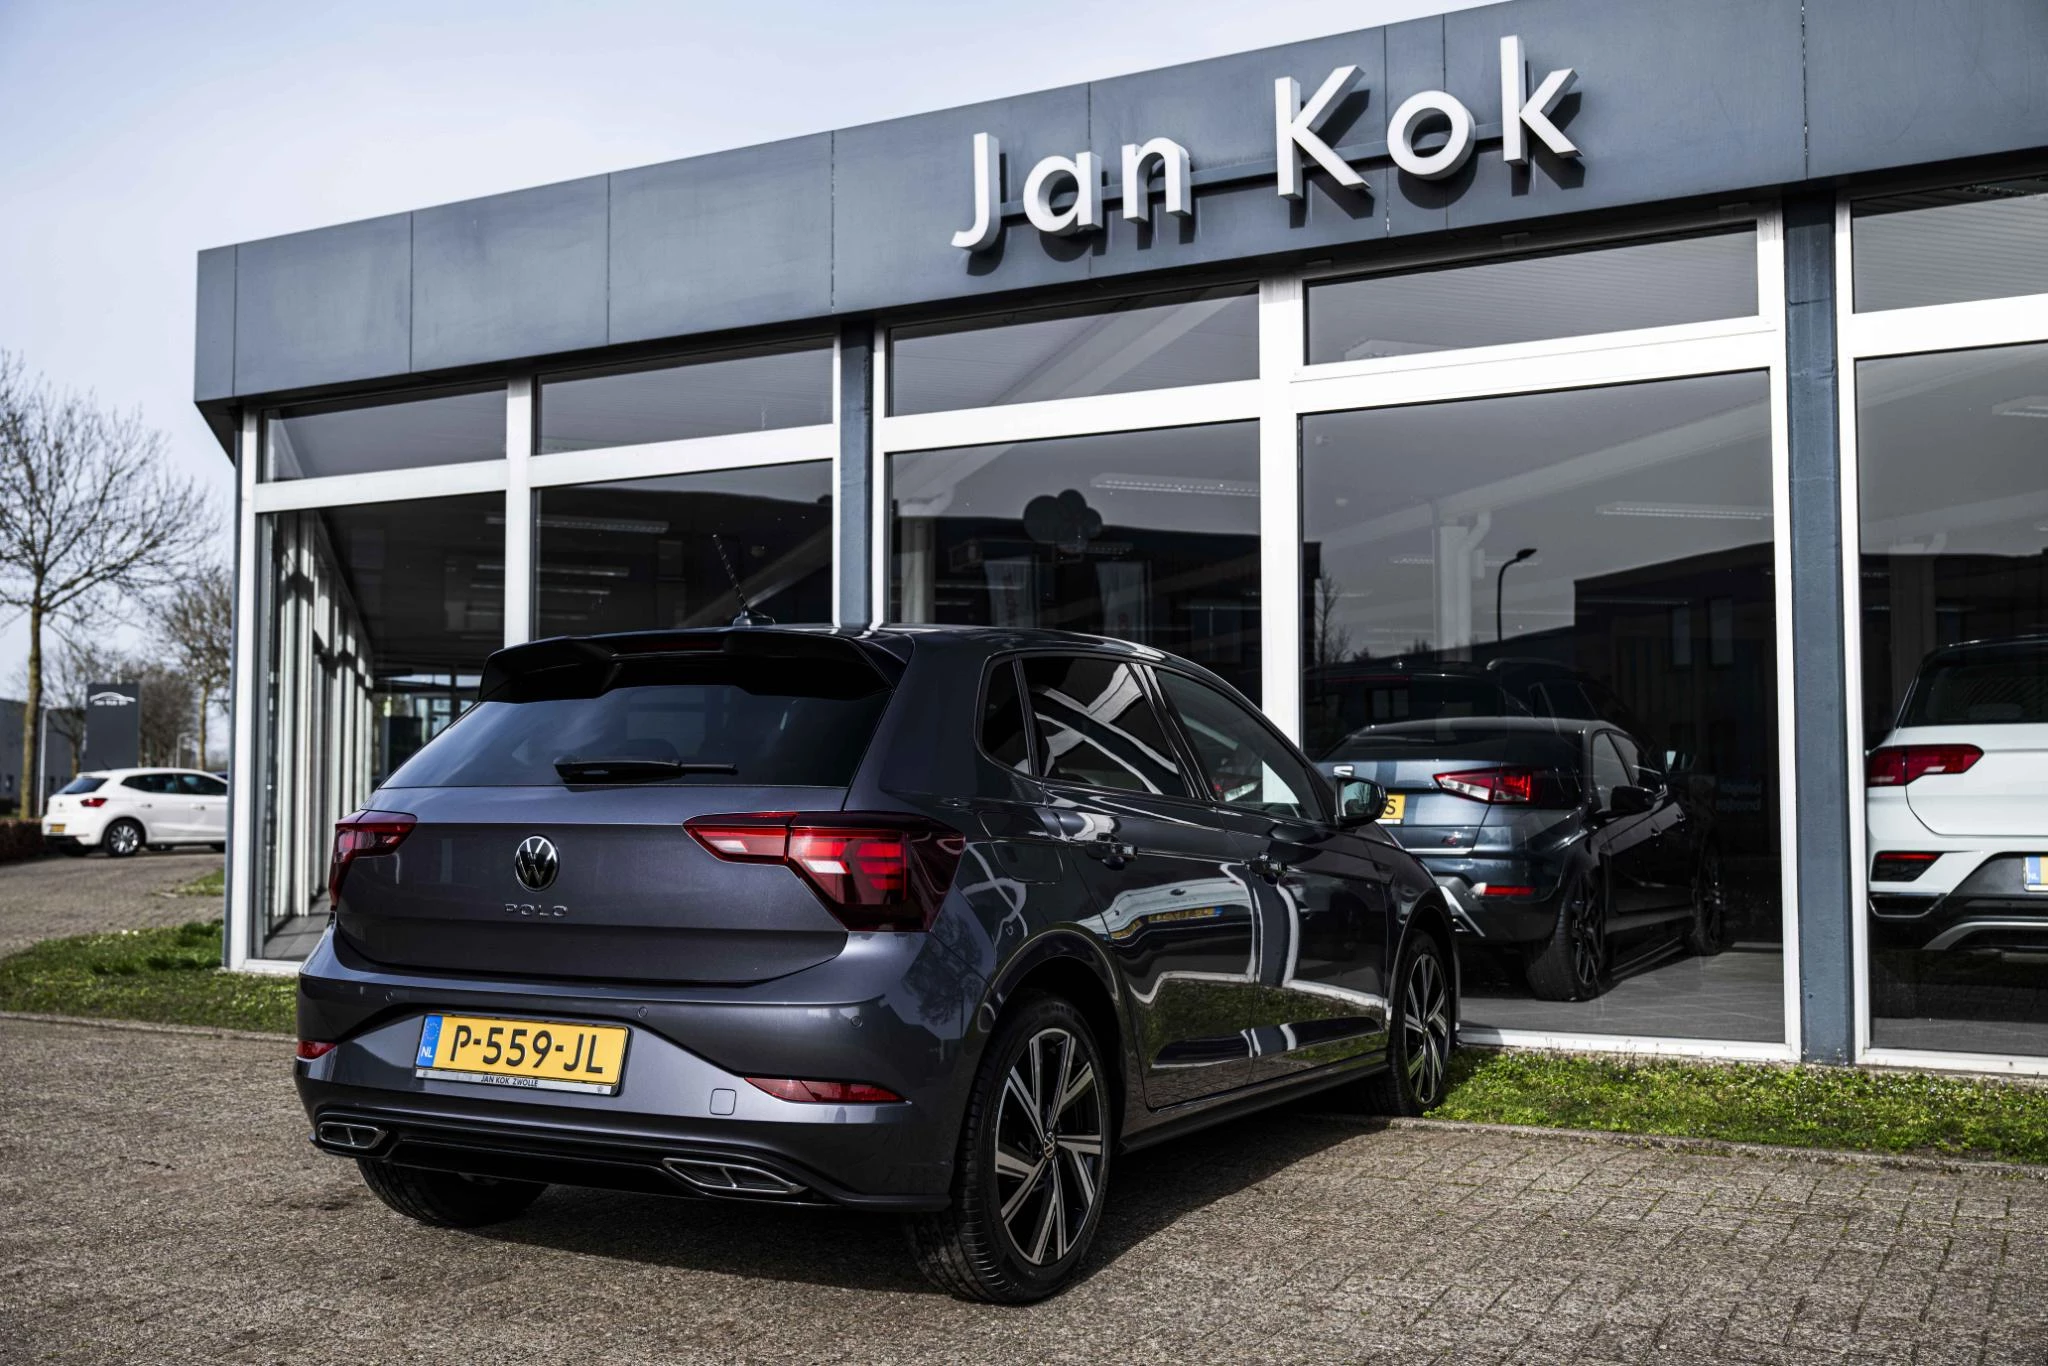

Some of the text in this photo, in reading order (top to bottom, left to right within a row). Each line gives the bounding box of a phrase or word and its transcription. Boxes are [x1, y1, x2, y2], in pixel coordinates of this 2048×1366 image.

[951, 35, 1584, 252] Jan Kok
[504, 903, 569, 917] POLO
[420, 1045, 433, 1058] NL
[449, 1025, 604, 1074] P-559-JL
[481, 1075, 539, 1087] JAN KOK ZWOLLE
